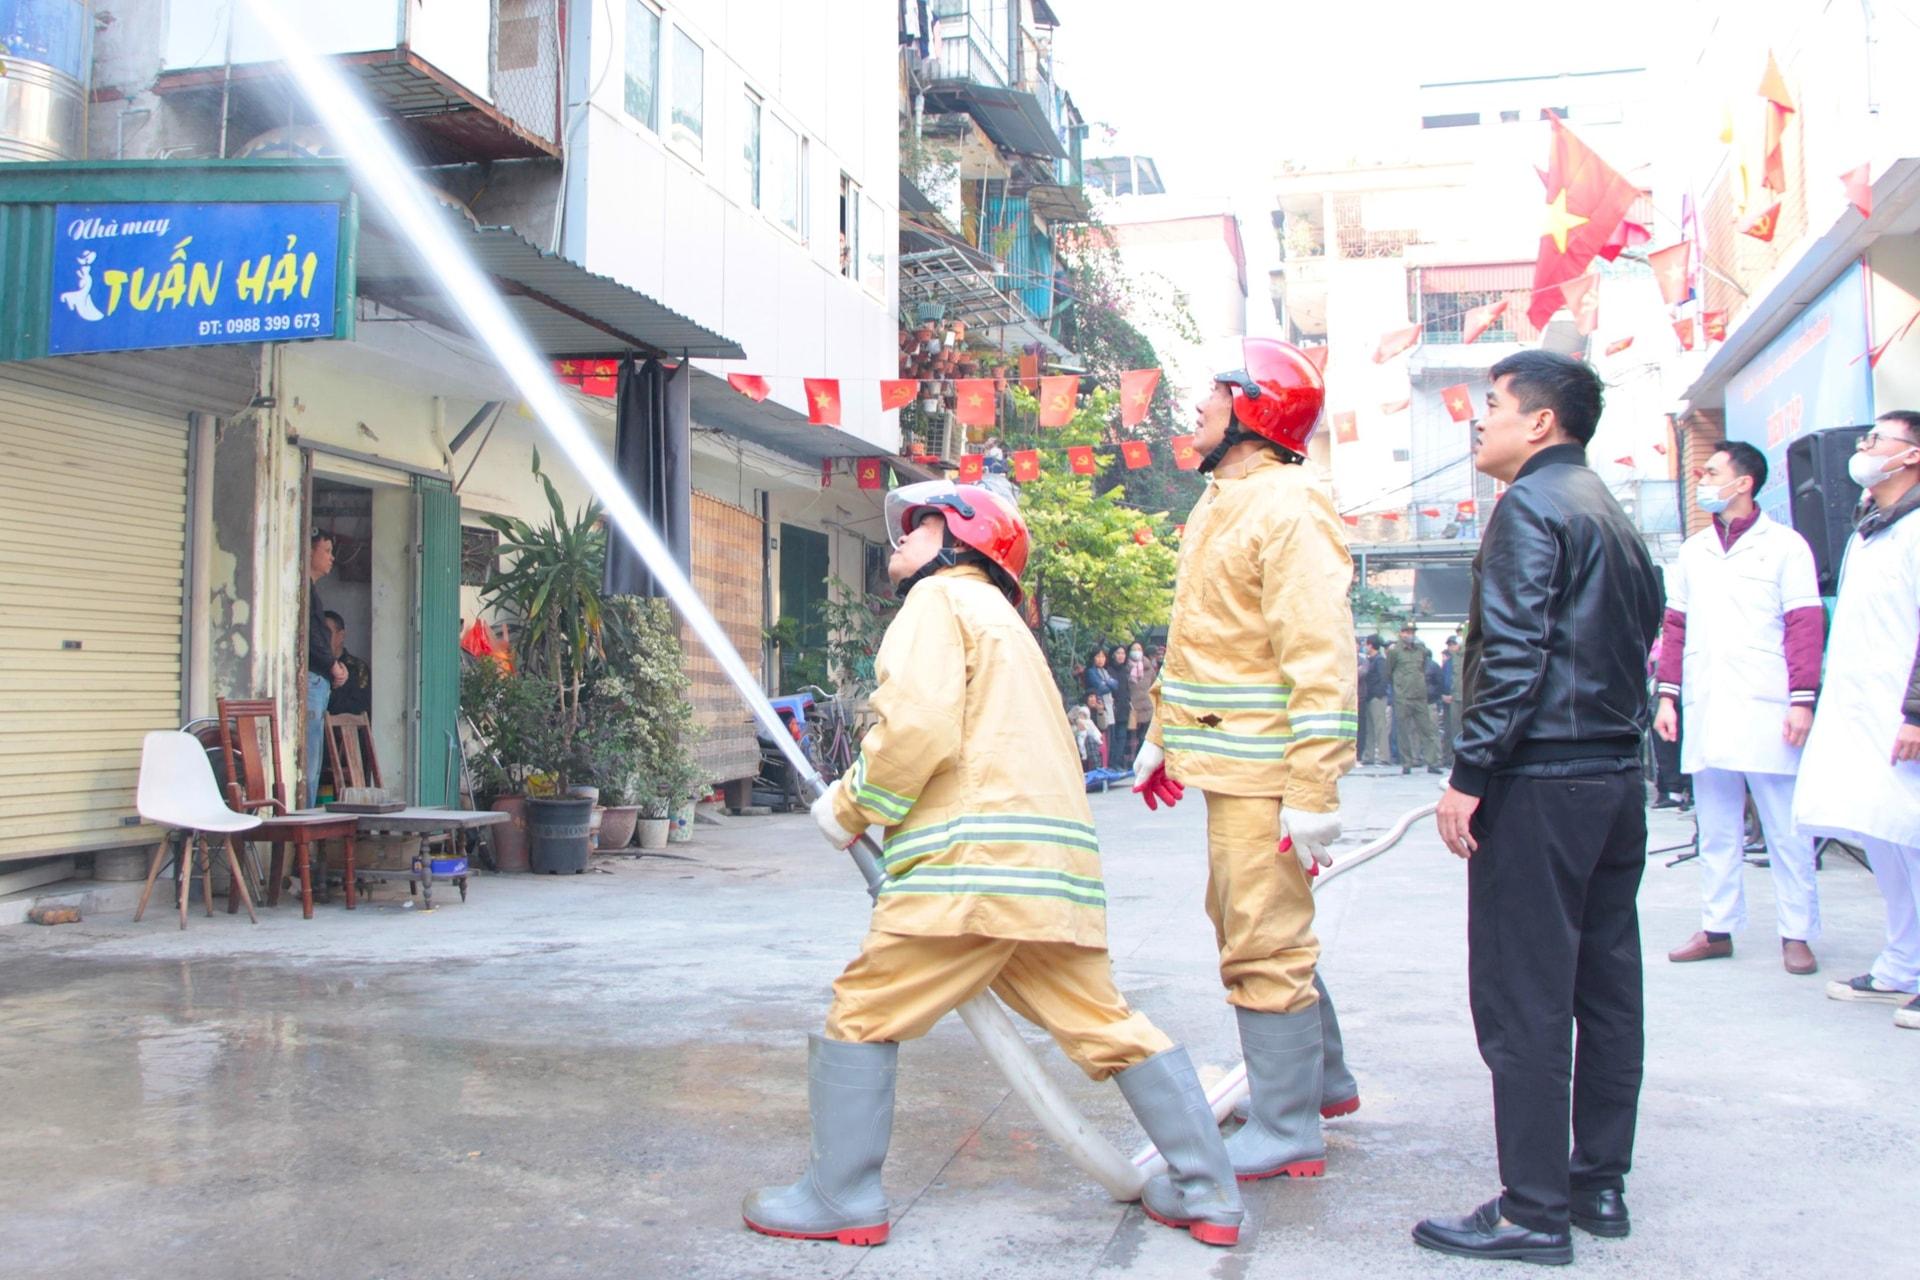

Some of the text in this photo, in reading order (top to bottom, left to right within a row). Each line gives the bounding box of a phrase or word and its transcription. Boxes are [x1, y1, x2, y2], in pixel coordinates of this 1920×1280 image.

[68, 218, 170, 240] Nhà may
[104, 233, 318, 316] TUẤN HẢI
[199, 312, 320, 336] ĐT: 0988 399 673
